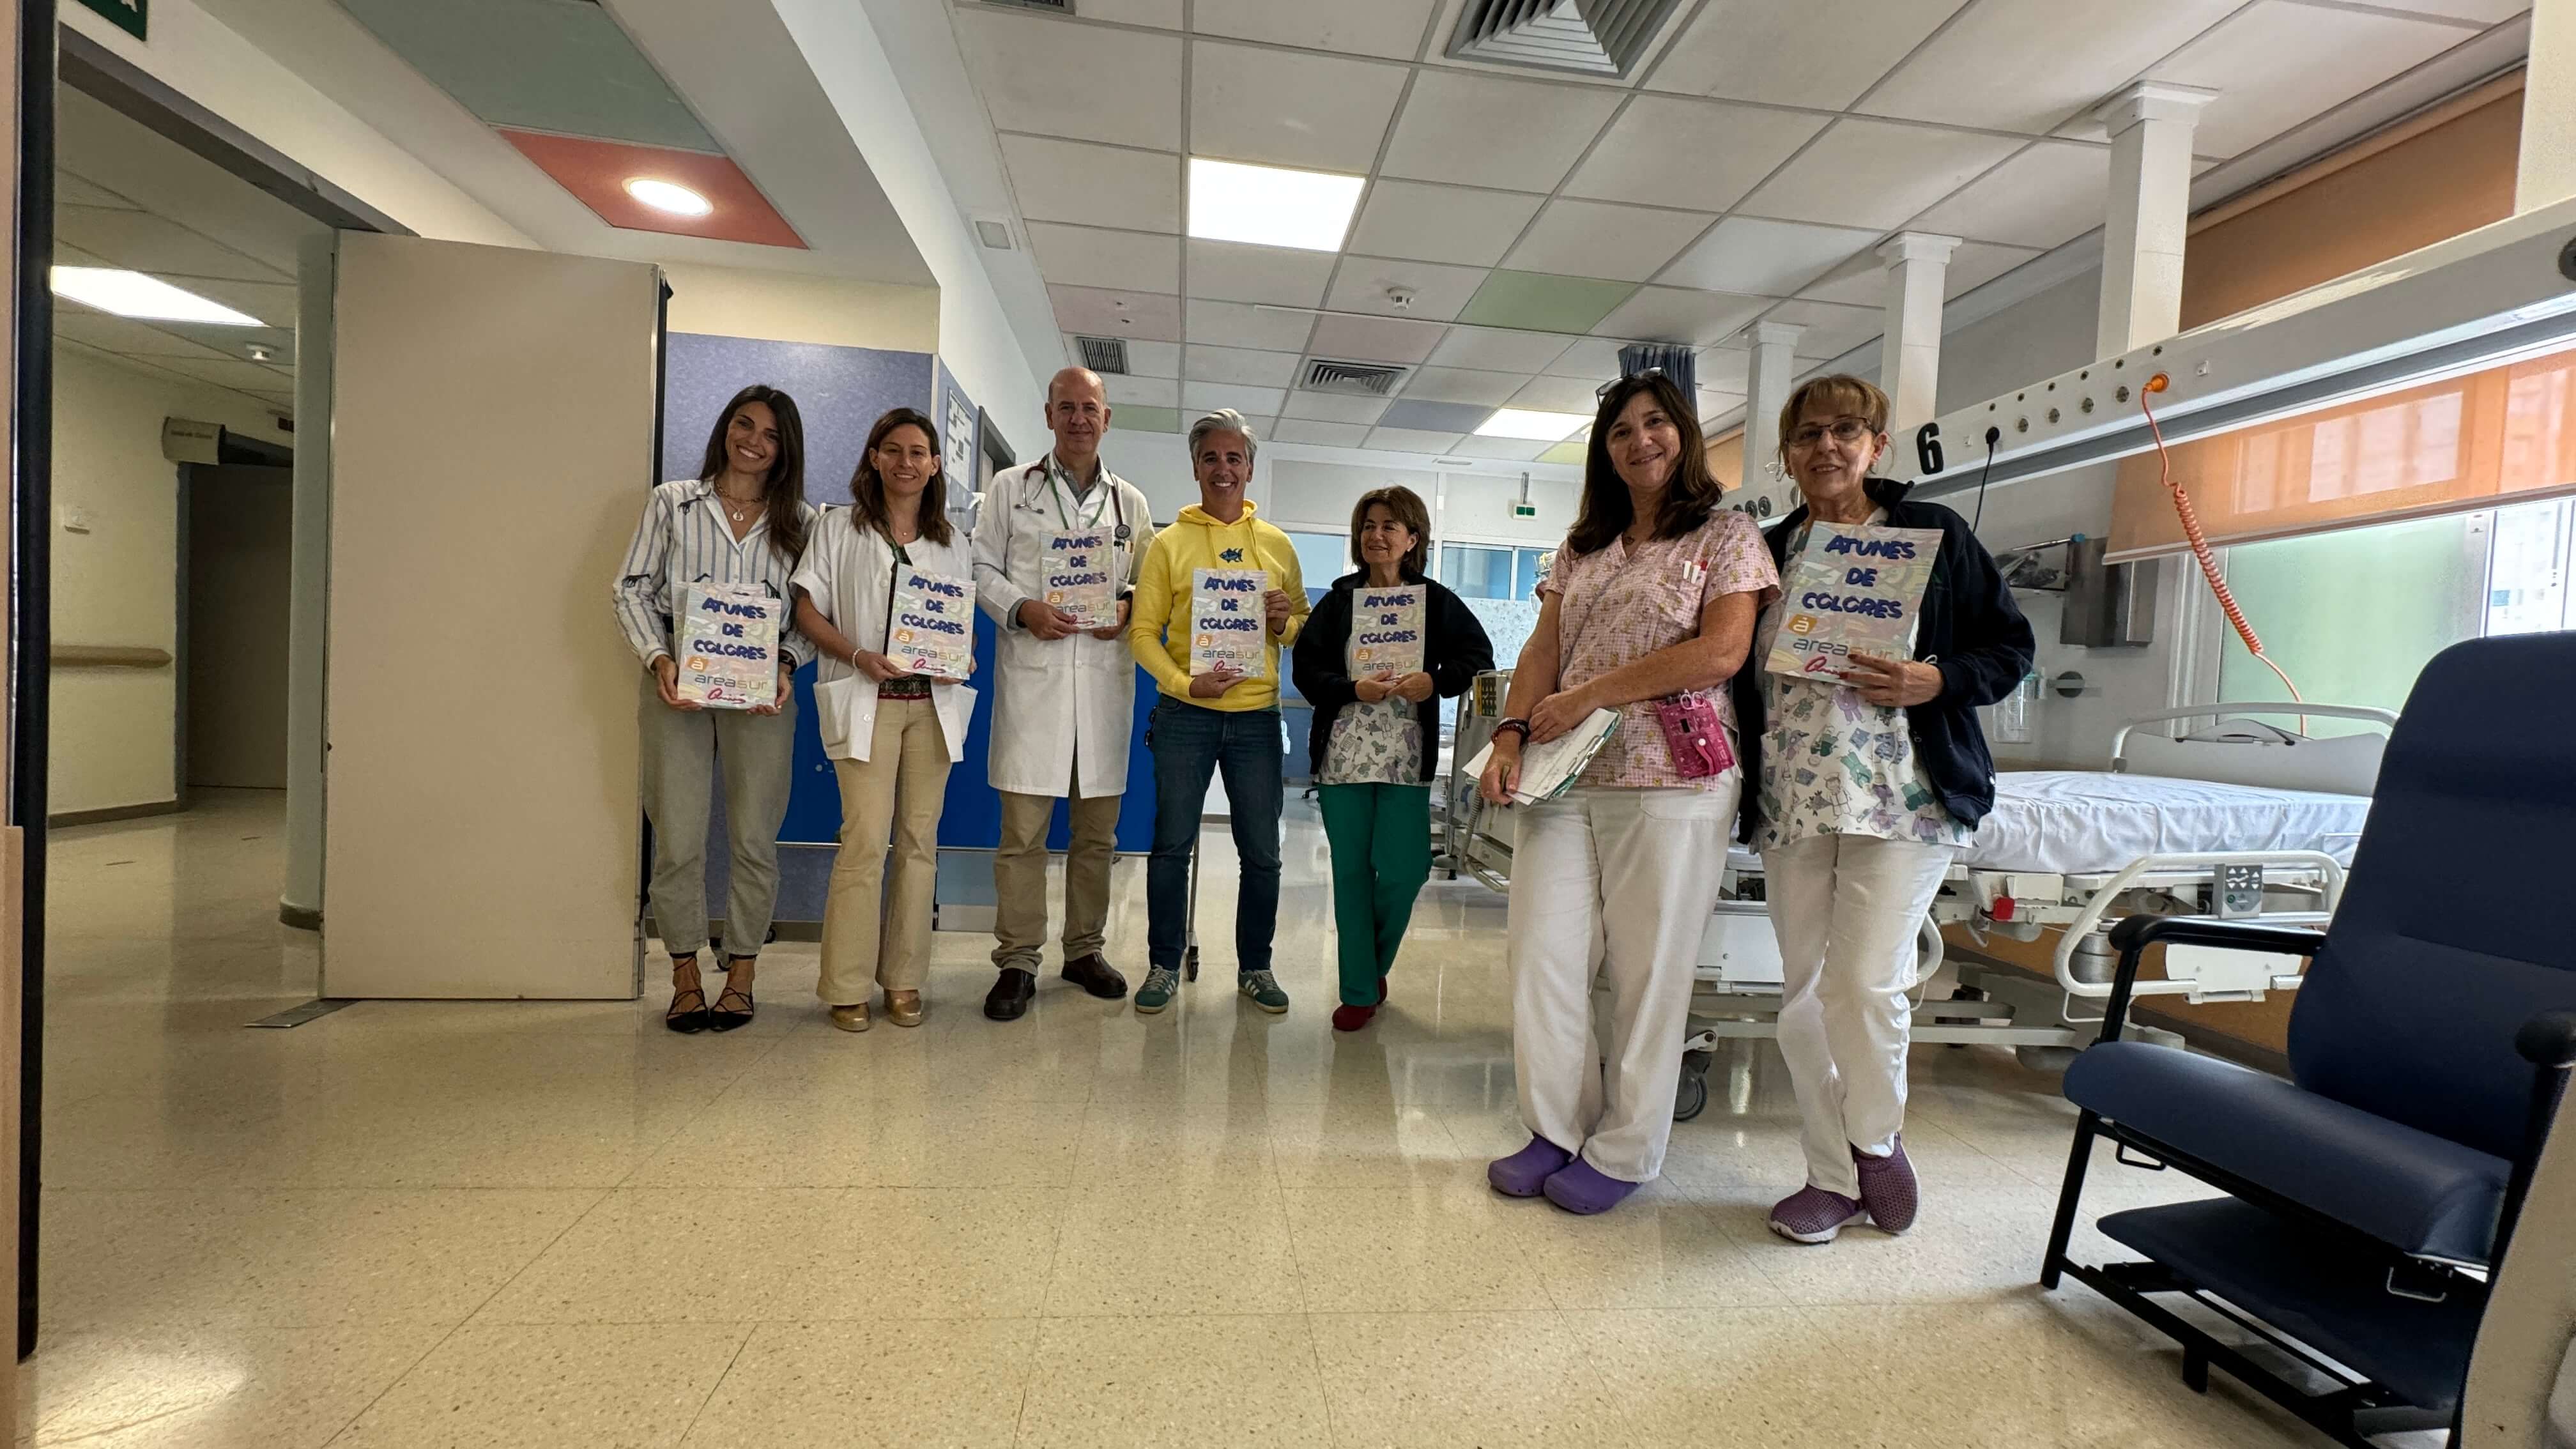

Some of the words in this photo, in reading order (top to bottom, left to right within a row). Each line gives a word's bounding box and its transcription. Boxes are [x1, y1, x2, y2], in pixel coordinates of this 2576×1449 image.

[1917, 422, 1943, 475] 6
[1052, 536, 1103, 549] ATUNES
[1825, 535, 1916, 559] ATUNES
[1070, 555, 1087, 567] DE
[1050, 572, 1107, 586] COLORES
[1845, 567, 1877, 586] DE
[908, 575, 964, 597] ATUNES
[1204, 577, 1256, 592] ATUNES
[702, 597, 767, 618] ATUNES
[925, 599, 944, 613] DE
[1221, 599, 1238, 611] DE
[1364, 594, 1415, 608] ATUNES
[1802, 592, 1903, 618] COLORES
[901, 613, 964, 634] COLORES
[1200, 618, 1258, 631] COLORES
[1381, 613, 1398, 625] DE
[722, 623, 744, 638] DE
[1360, 630, 1417, 644] COLORES
[693, 640, 767, 659] COLORES
[901, 645, 964, 662] areasur
[1202, 650, 1260, 659] areasur
[1363, 660, 1418, 670] areasur
[694, 674, 767, 689] areasur
